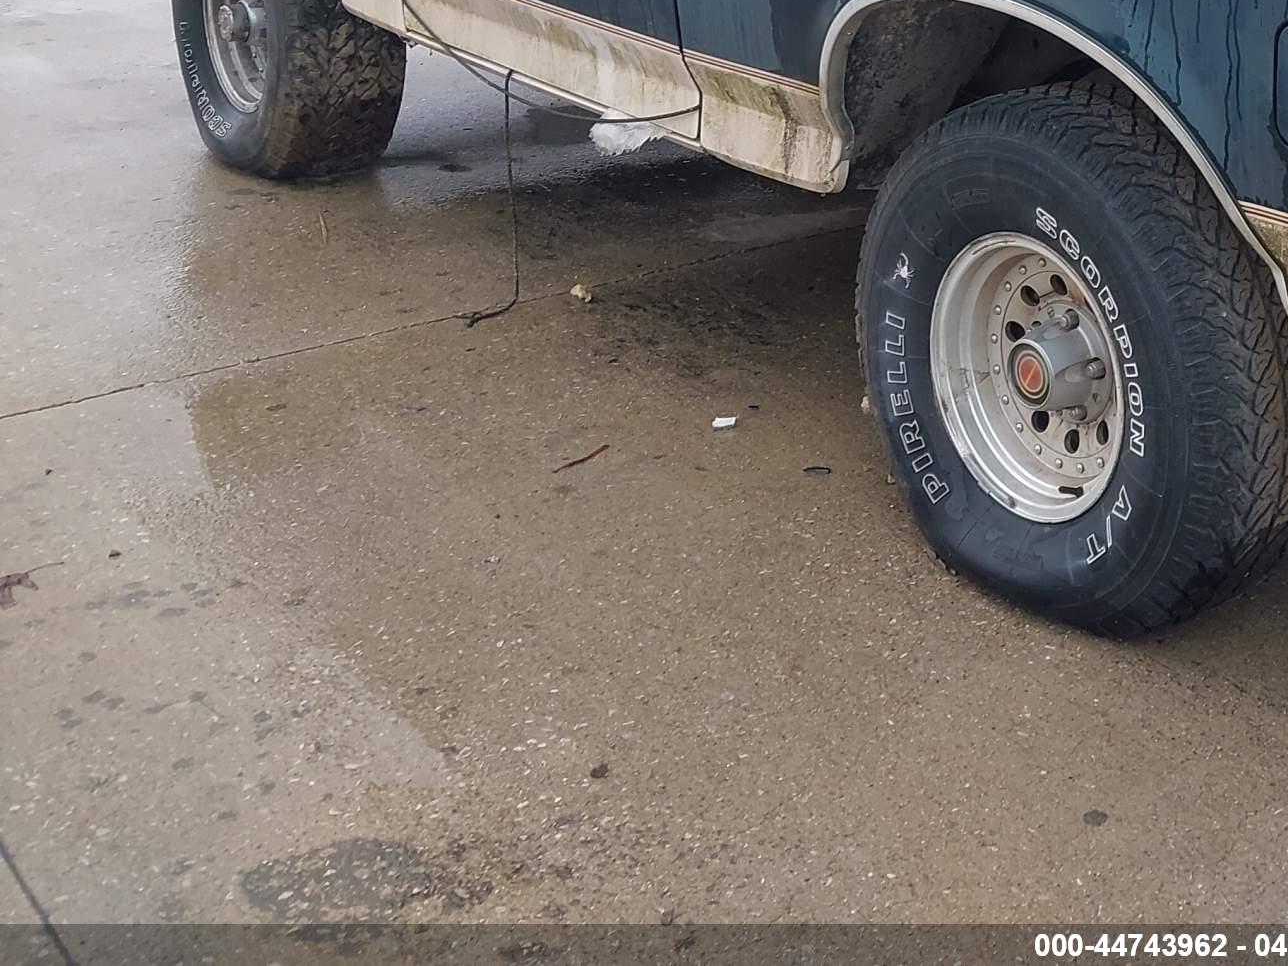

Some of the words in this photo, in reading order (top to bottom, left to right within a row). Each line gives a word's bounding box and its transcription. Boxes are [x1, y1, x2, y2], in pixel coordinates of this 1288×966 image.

[885, 312, 950, 505] PIRELLI
[1035, 206, 1146, 458] SCORPION
[1085, 484, 1133, 565] A/T
